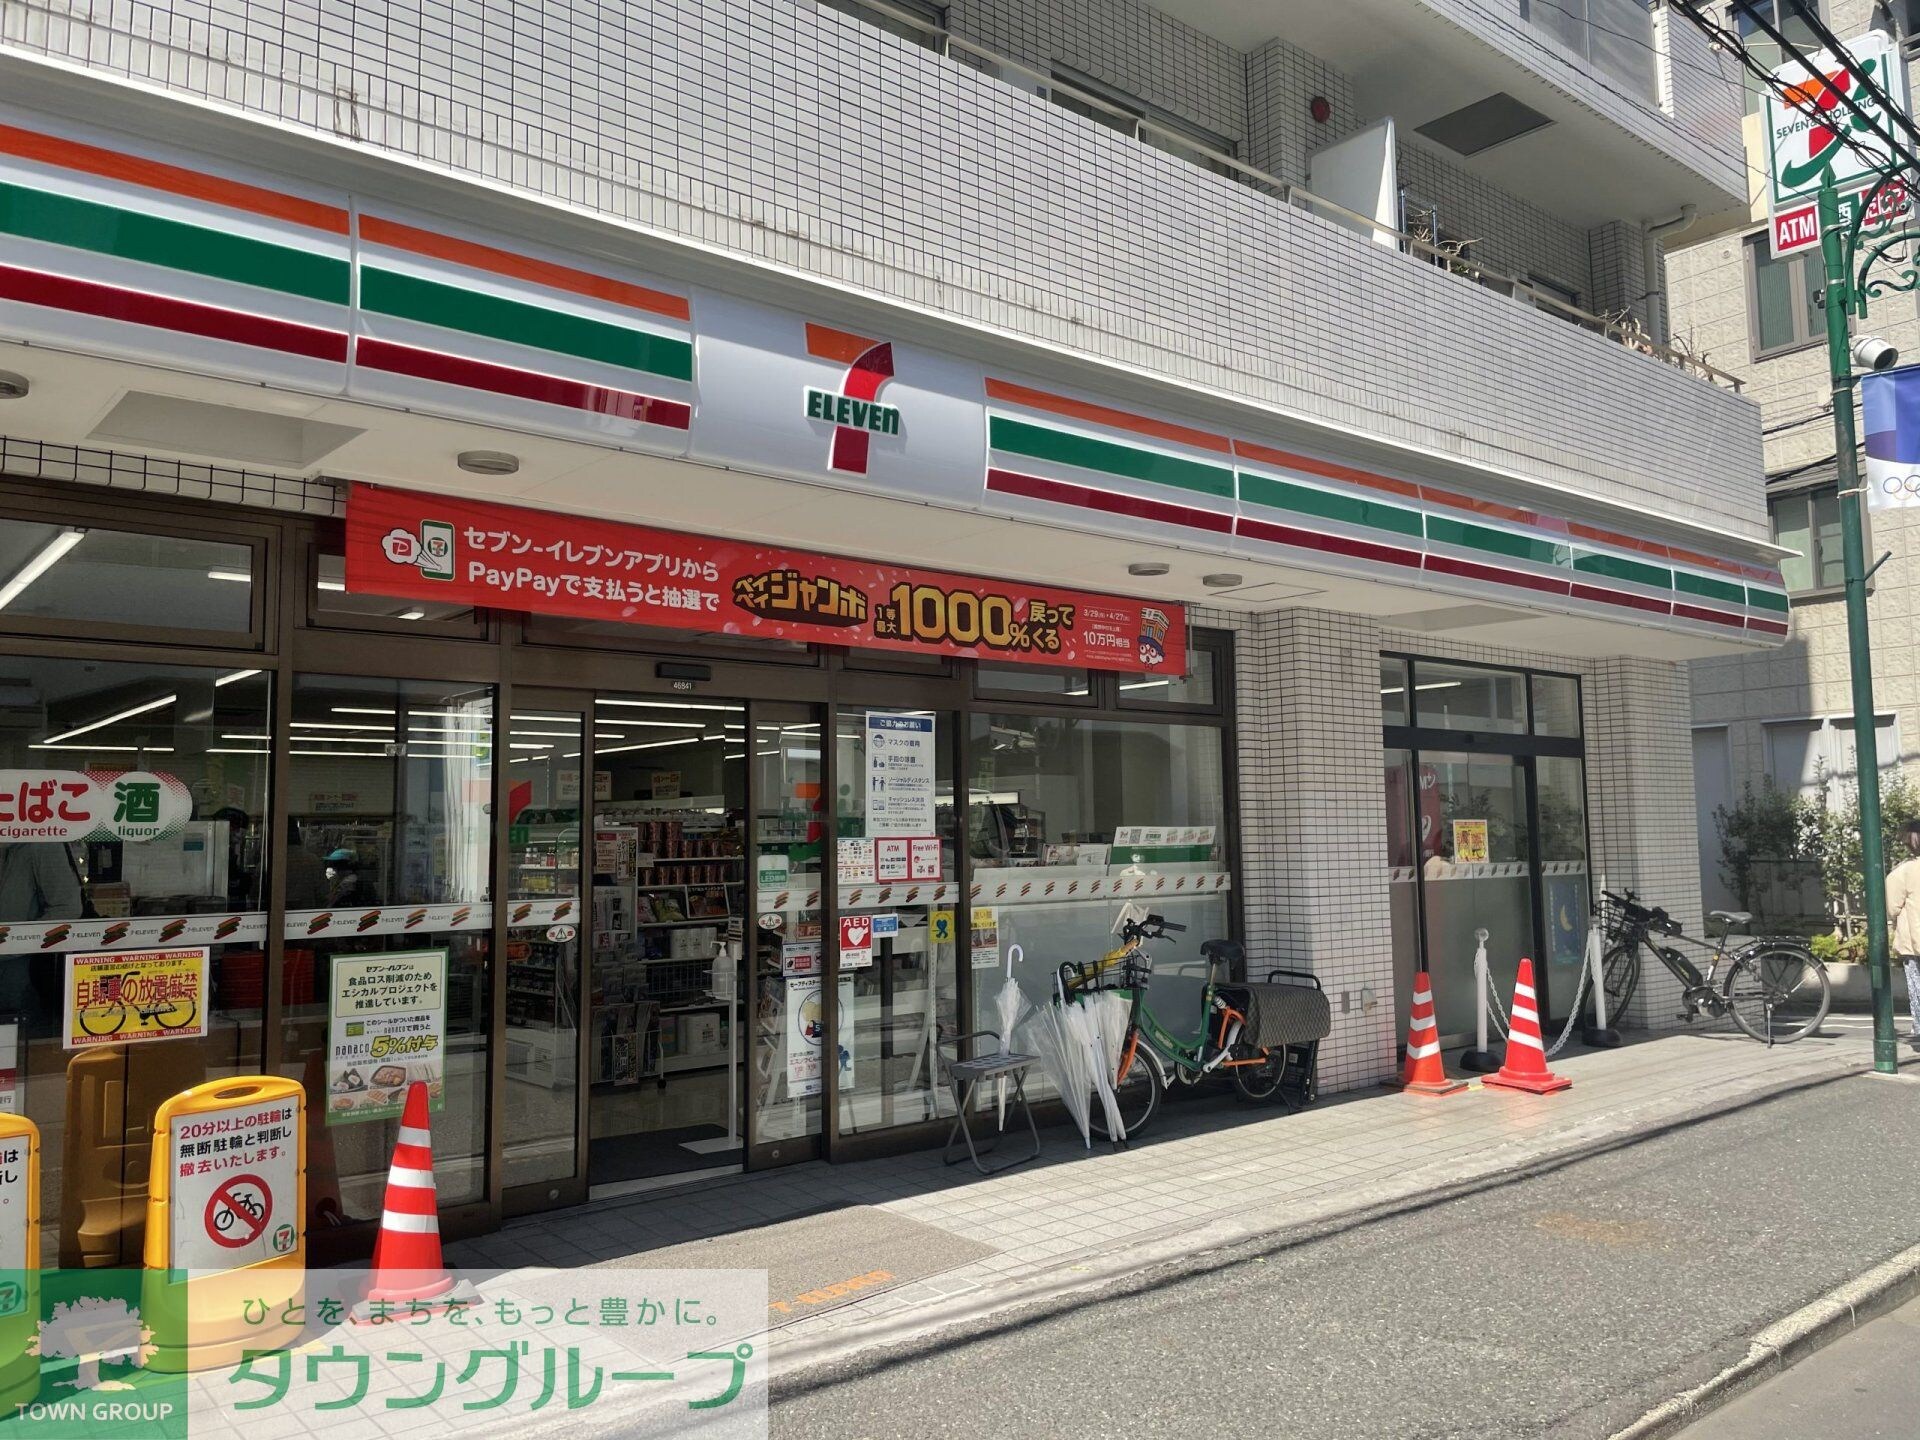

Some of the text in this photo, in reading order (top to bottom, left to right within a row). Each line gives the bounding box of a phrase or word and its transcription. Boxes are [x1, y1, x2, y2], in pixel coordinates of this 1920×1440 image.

[1779, 213, 1815, 245] ATM
[468, 561, 720, 611] PayPayで支払うと抽選で
[771, 571, 866, 620] ジャンボ
[1030, 601, 1074, 626] 戻って
[876, 620, 897, 634] 最大
[1032, 626, 1060, 650] くる
[113, 781, 161, 823] 酒
[0, 825, 160, 839] cigarette liquor
[842, 917, 870, 928] AED
[76, 951, 202, 965] WARNING WARNING WARNING
[341, 982, 438, 998] エシカルプロジェクトを
[348, 972, 432, 987] 食品ロス削減のため
[355, 995, 423, 1010] 推進しています。
[73, 1027, 201, 1045] WARNING WARNING WARNING
[335, 1043, 370, 1056] nanaco
[180, 1108, 292, 1140] 20分以上の駐輪は
[179, 1126, 292, 1159] 無断駐輪と判断し
[179, 1145, 287, 1178] 撤去いたします。
